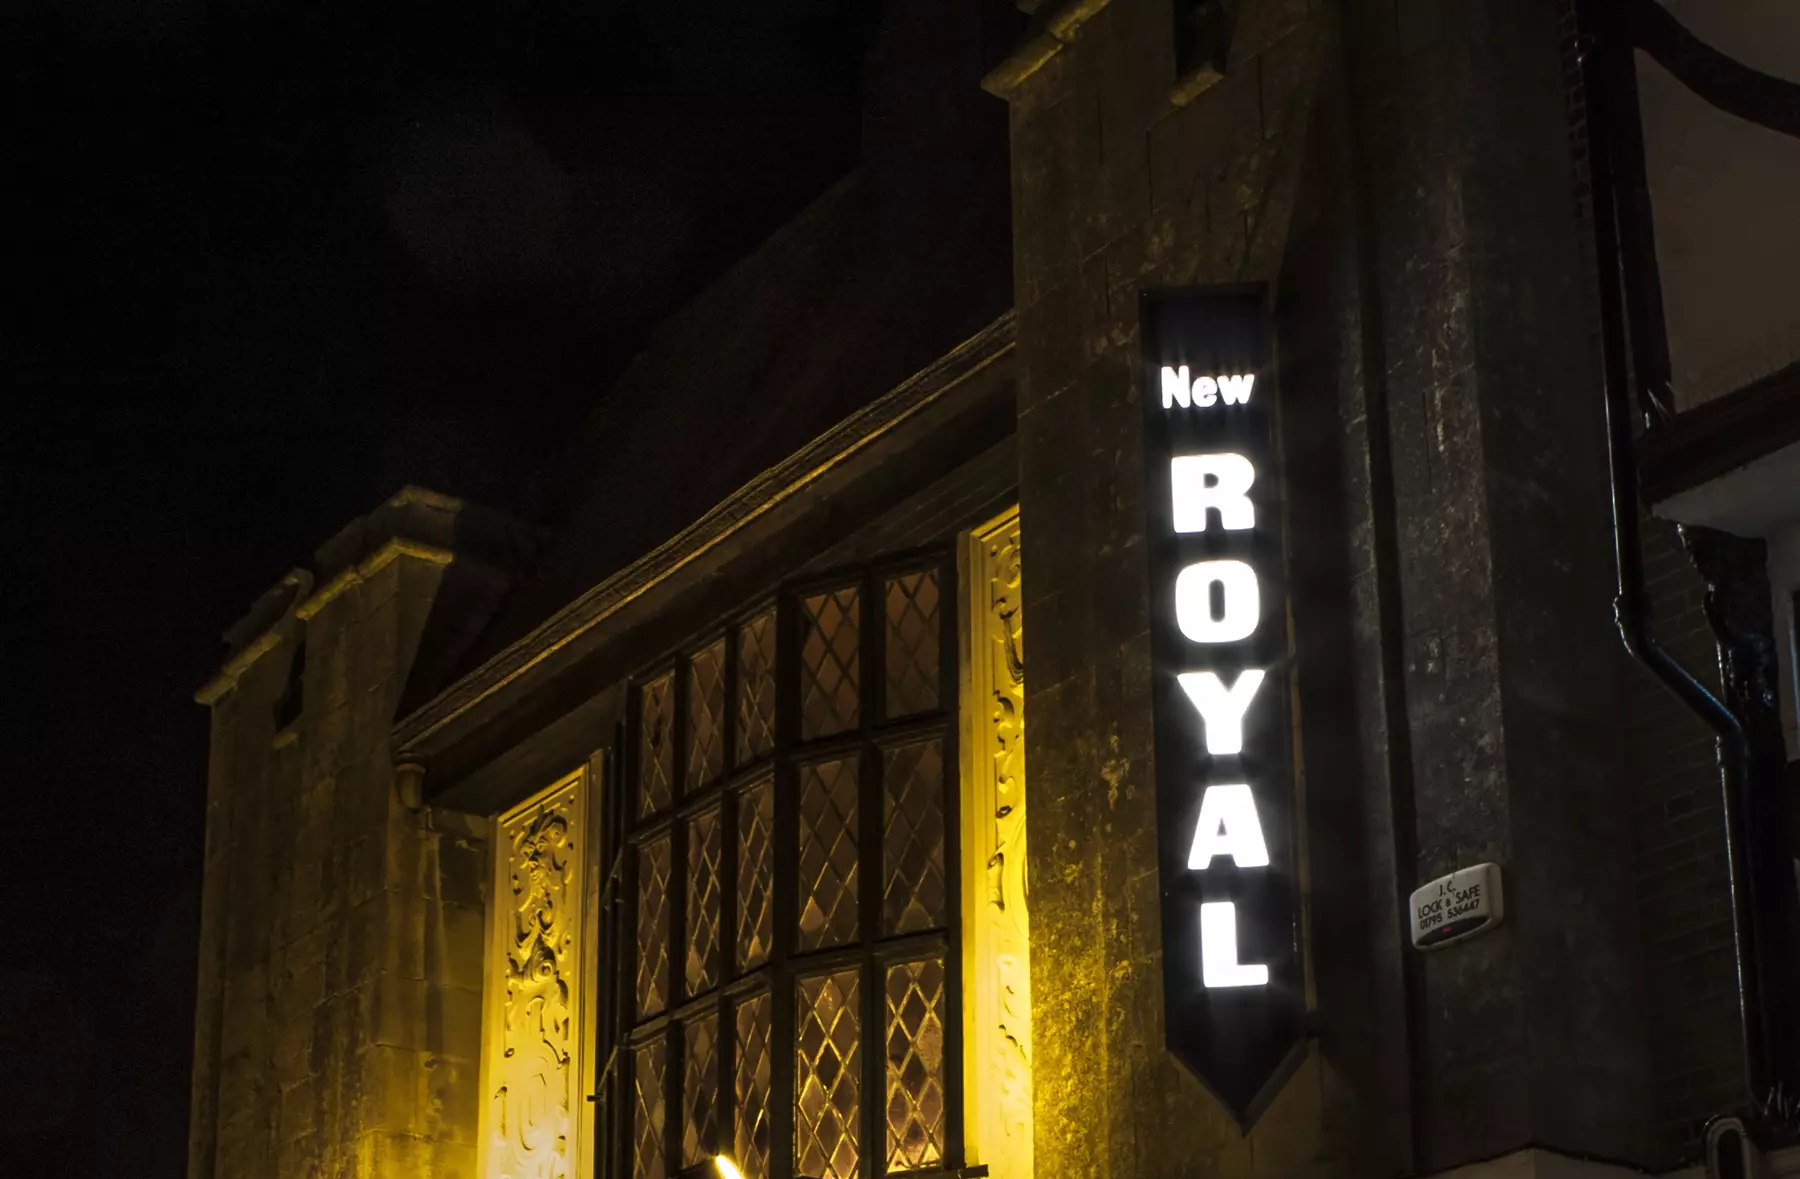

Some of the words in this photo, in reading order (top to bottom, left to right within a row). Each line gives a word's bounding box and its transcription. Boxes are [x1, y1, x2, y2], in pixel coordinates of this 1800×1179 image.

[1160, 364, 1254, 408] New
[1170, 452, 1270, 990] ROYAL
[1418, 899, 1443, 919] LOCK
[1456, 884, 1481, 904] SAFE
[1439, 881, 1456, 896] J.C.
[1420, 913, 1443, 930] 01795
